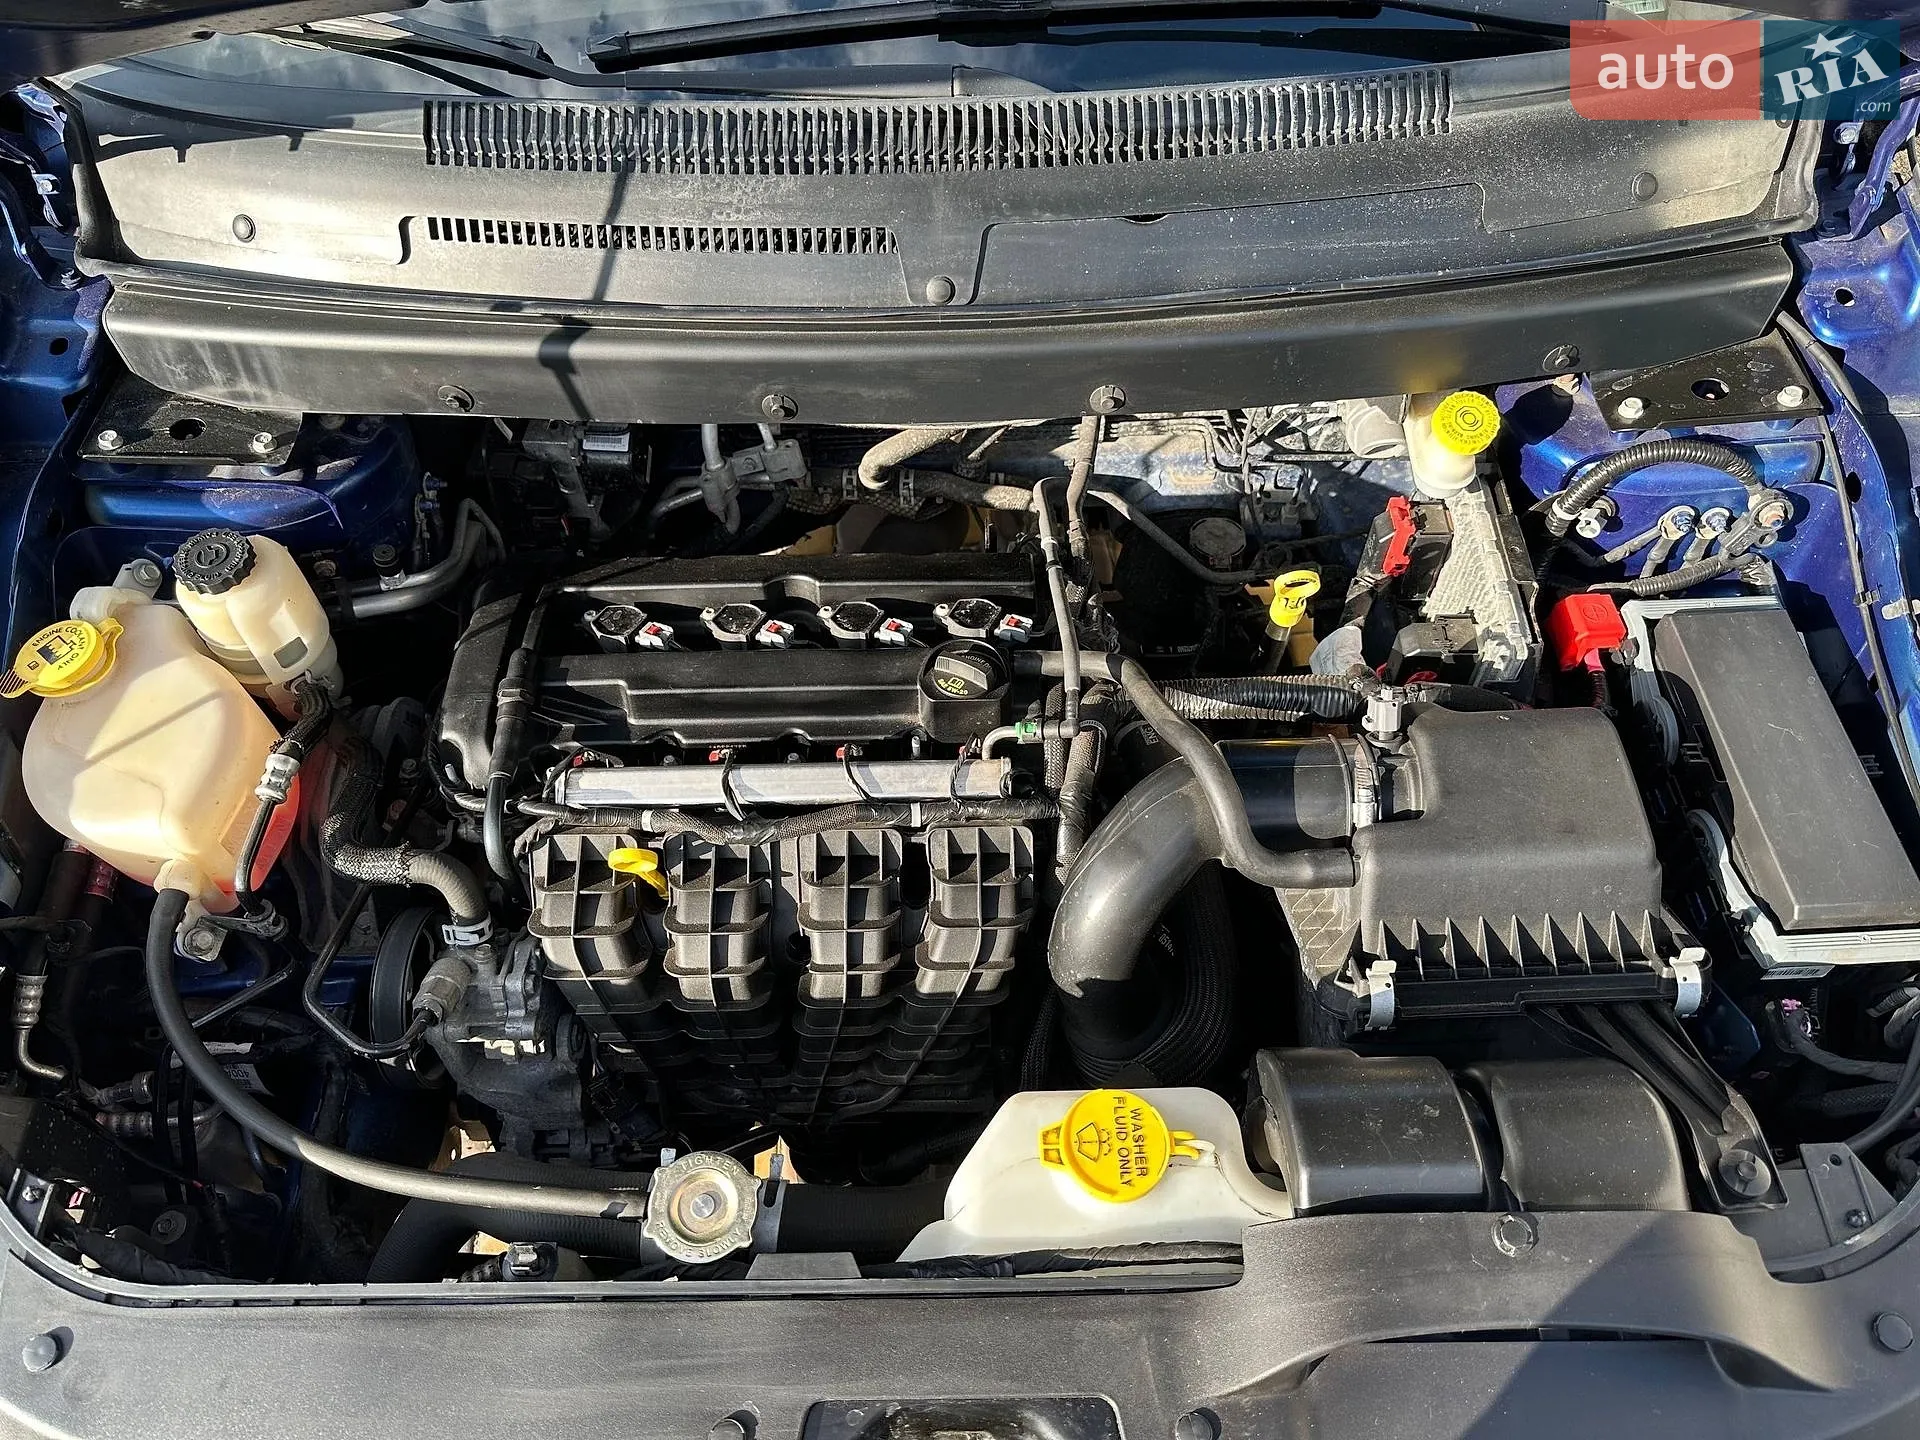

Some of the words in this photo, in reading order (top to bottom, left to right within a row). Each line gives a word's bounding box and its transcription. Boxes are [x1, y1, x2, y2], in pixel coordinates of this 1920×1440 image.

[32, 627, 63, 647] ENGINE
[65, 626, 86, 650] COOLANT
[57, 652, 80, 671] ONLY
[1112, 1096, 1128, 1141] FLUID
[1130, 1107, 1148, 1178] WASHER
[680, 1153, 740, 1176] TIGHTEN
[1117, 1147, 1134, 1187] ONLY
[656, 1221, 693, 1258] REMOVE
[697, 1227, 741, 1258] SLOWLY
